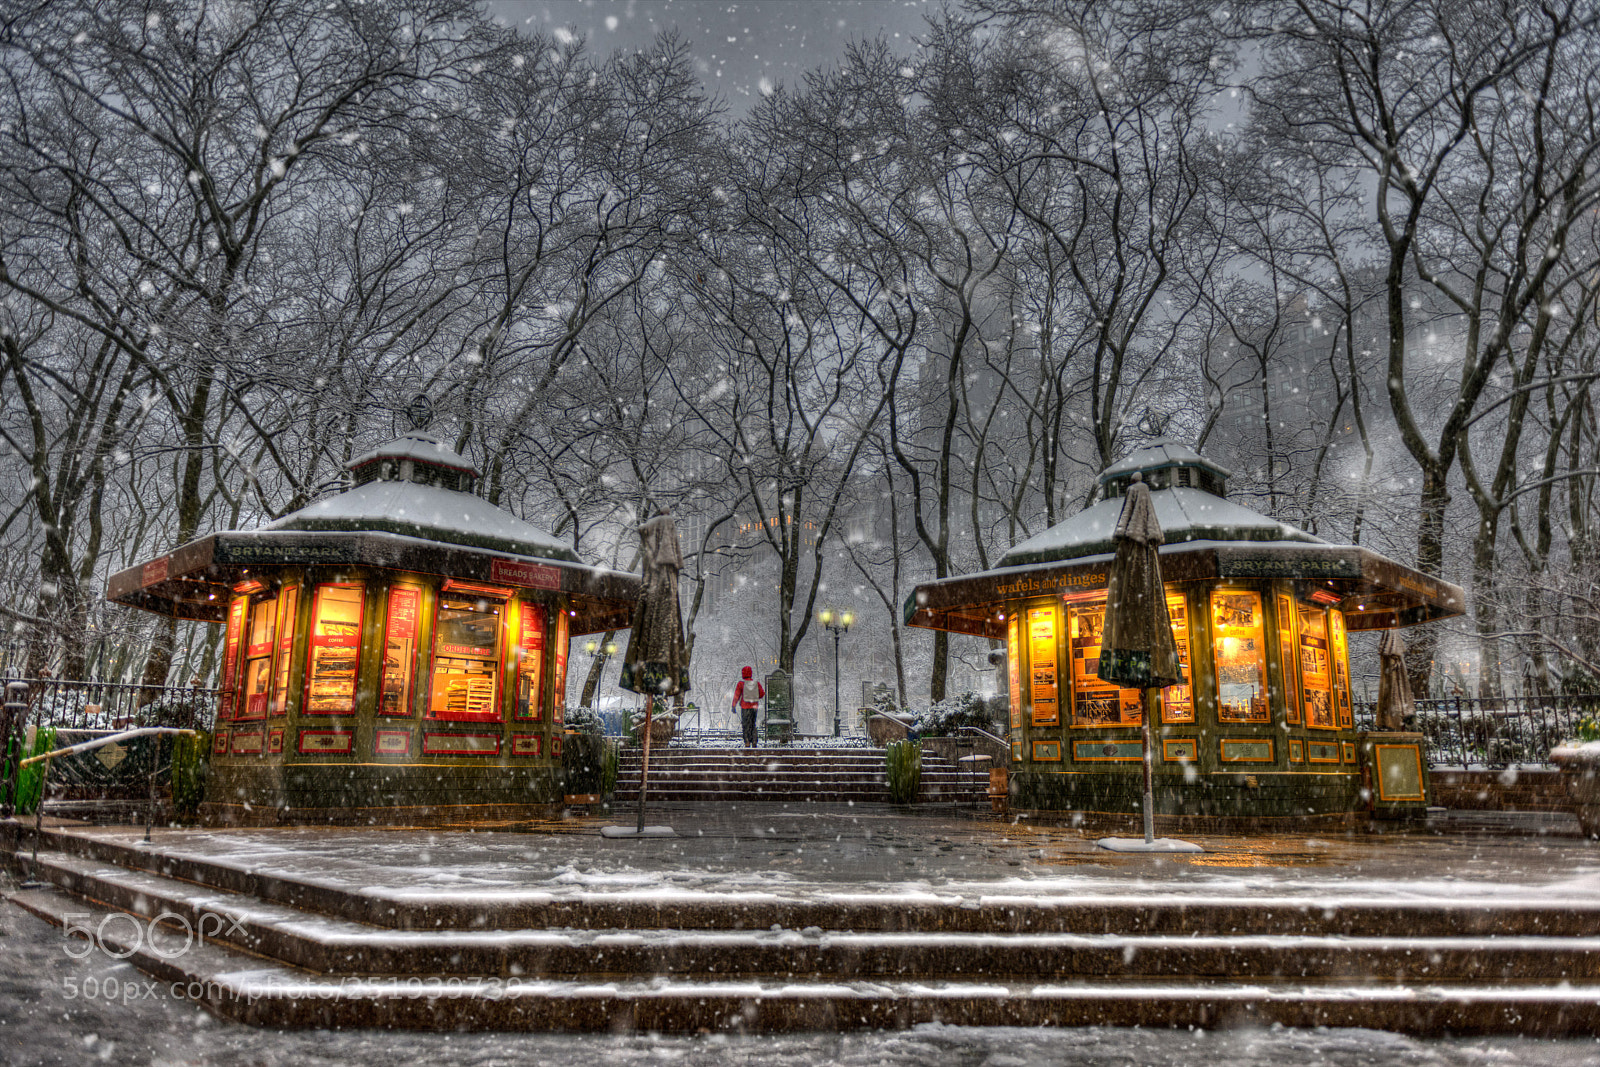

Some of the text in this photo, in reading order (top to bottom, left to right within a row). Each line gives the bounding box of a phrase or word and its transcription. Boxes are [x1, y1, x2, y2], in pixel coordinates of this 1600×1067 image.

[232, 546, 342, 557] BRYANT PARK
[1233, 560, 1343, 570] BRYANT PARK
[498, 567, 554, 582] BREADS BAKERY
[997, 573, 1106, 594] wafels and dinges
[444, 644, 491, 656] ORDER HERE
